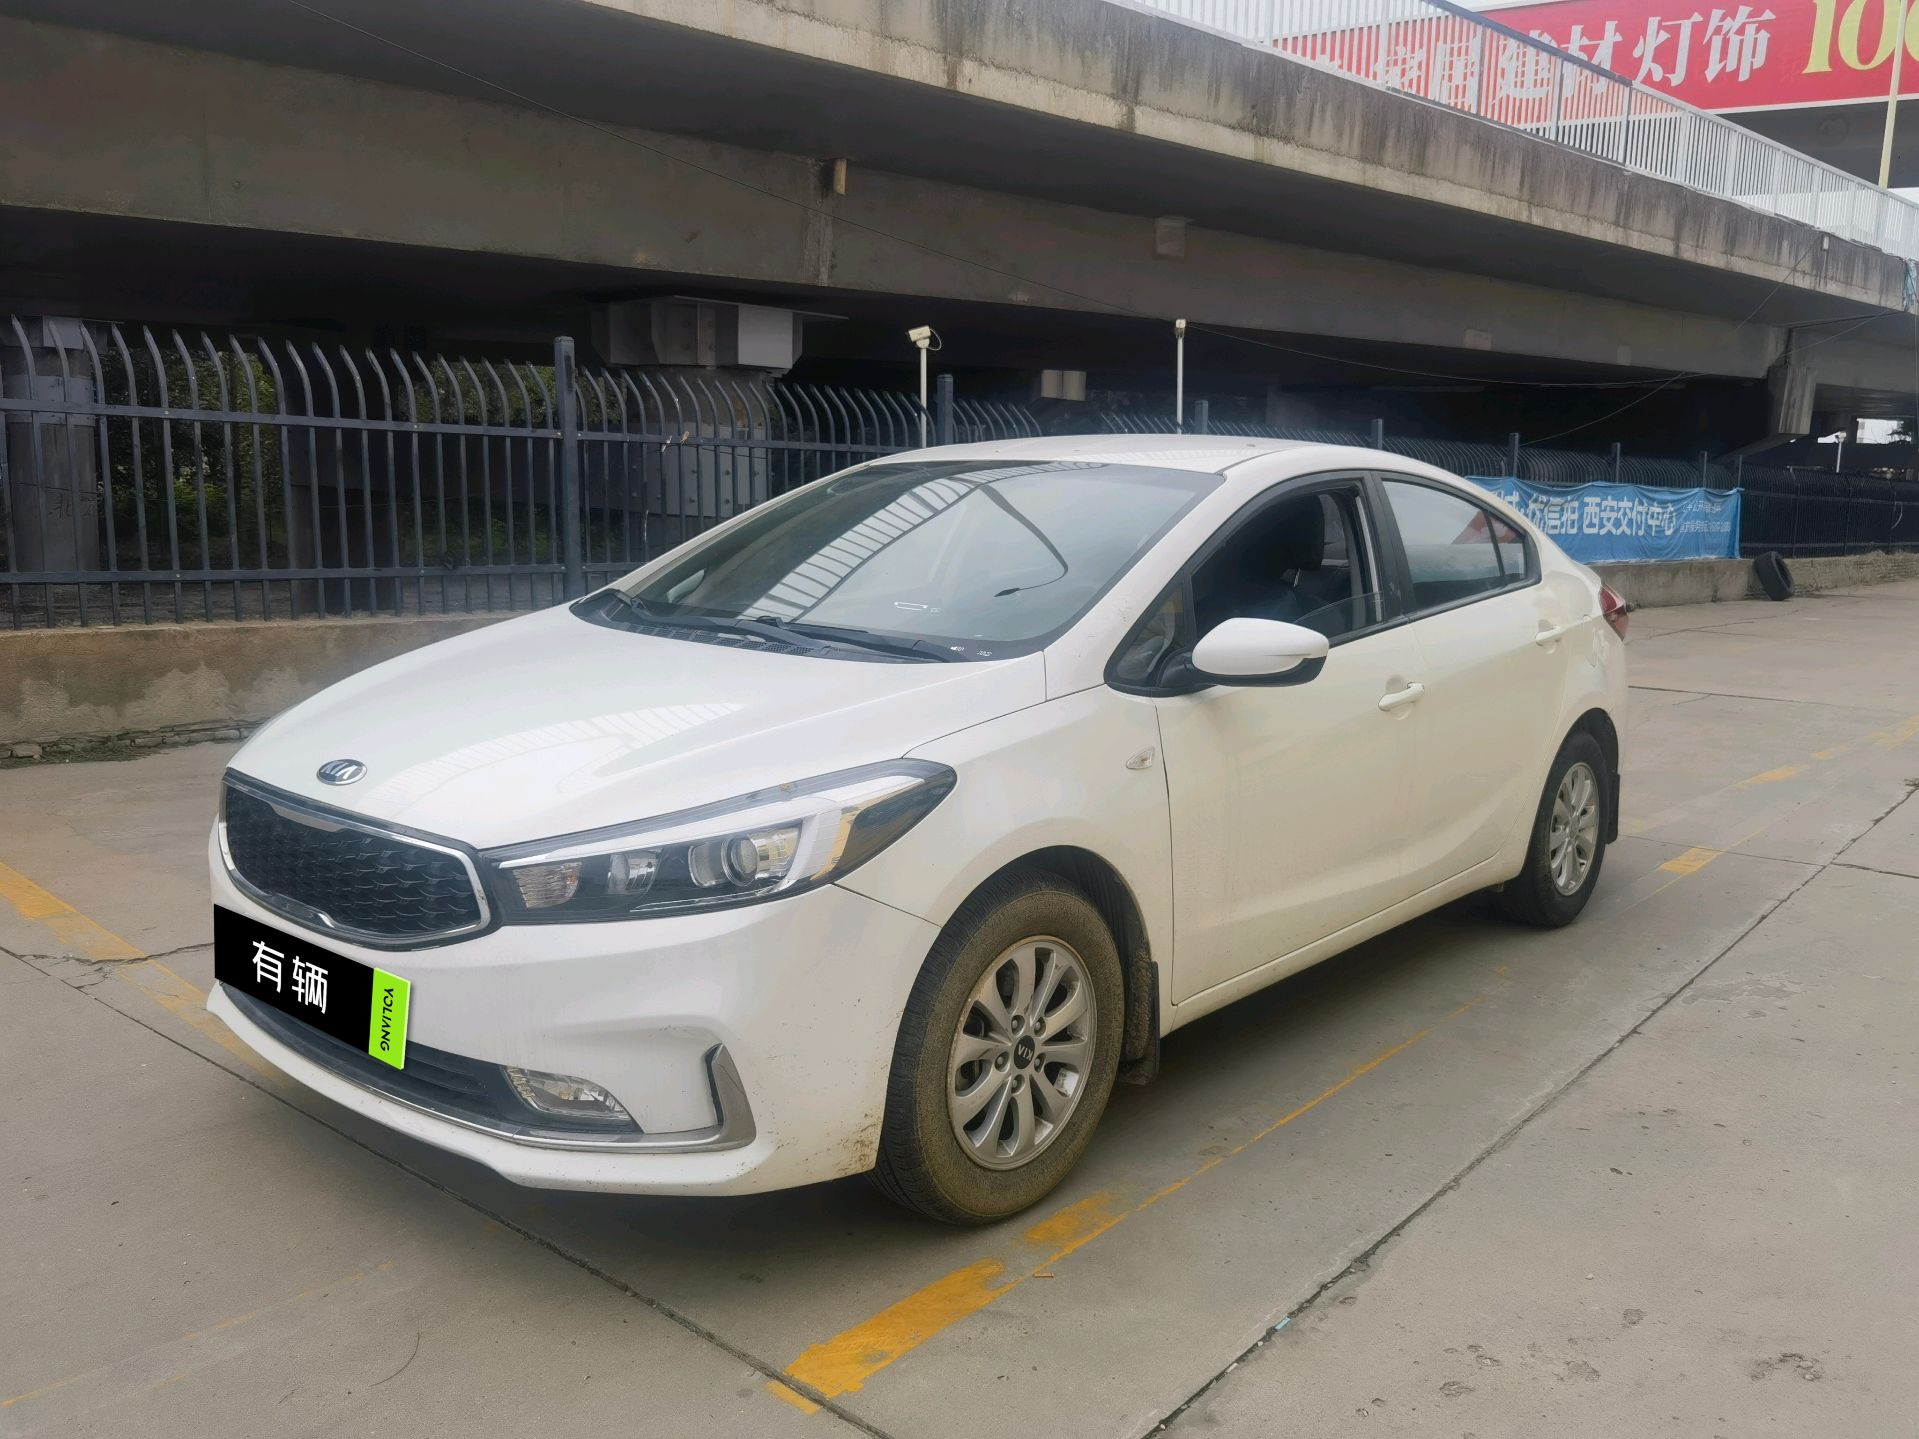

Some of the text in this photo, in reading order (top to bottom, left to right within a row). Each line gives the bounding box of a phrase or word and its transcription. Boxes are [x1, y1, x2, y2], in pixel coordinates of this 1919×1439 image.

[1802, 0, 1919, 73] 10
[1582, 495, 1676, 536] 西安交付中心
[1017, 1044, 1033, 1061] KIA
